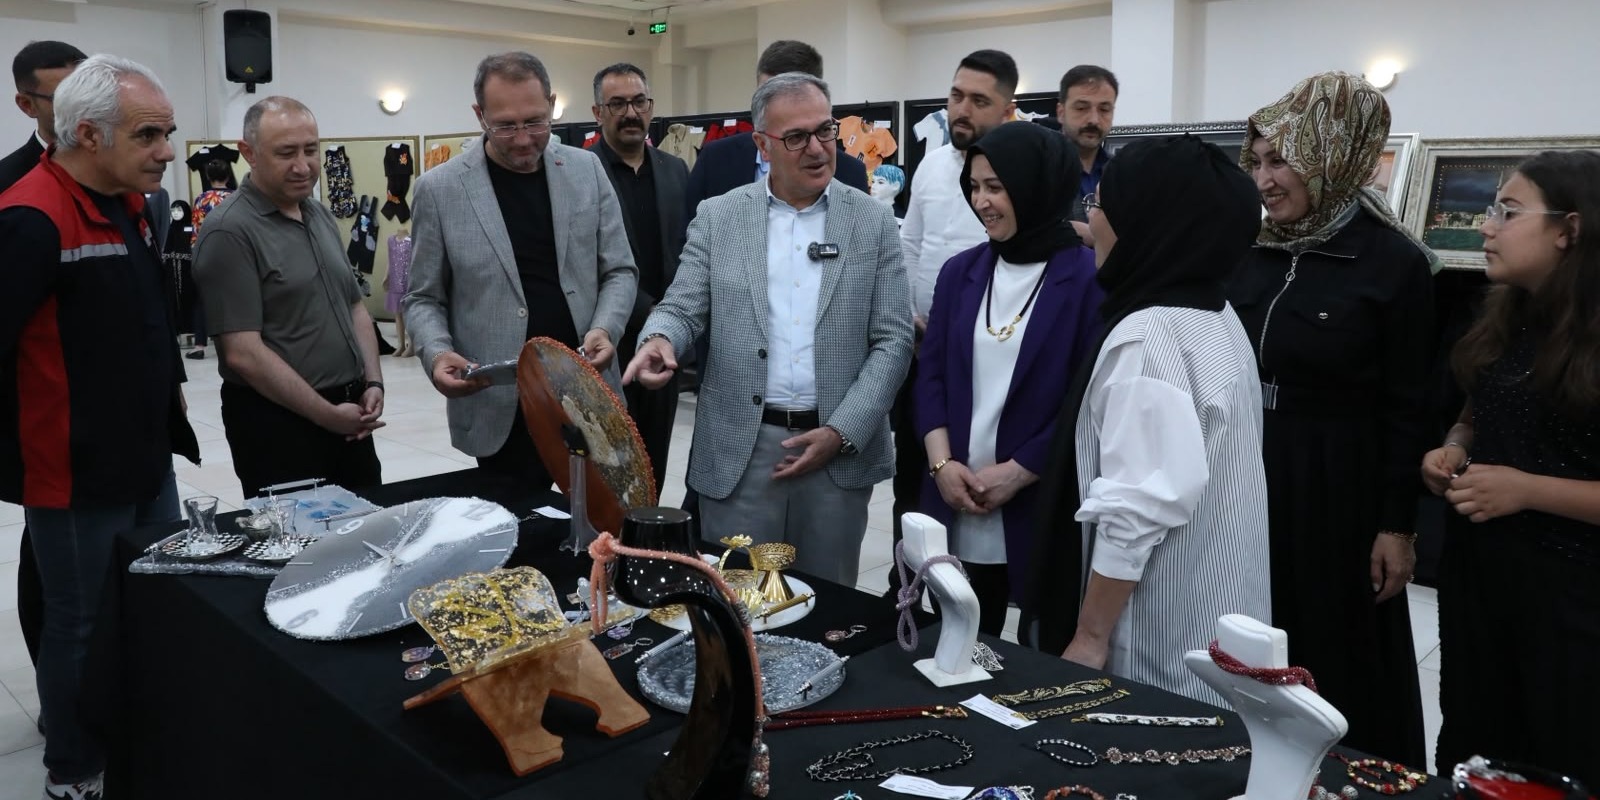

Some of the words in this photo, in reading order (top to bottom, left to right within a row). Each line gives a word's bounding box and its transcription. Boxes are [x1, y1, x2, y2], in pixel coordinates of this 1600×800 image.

[460, 501, 498, 521] 12
[336, 519, 365, 535] 9
[286, 609, 319, 629] 6
